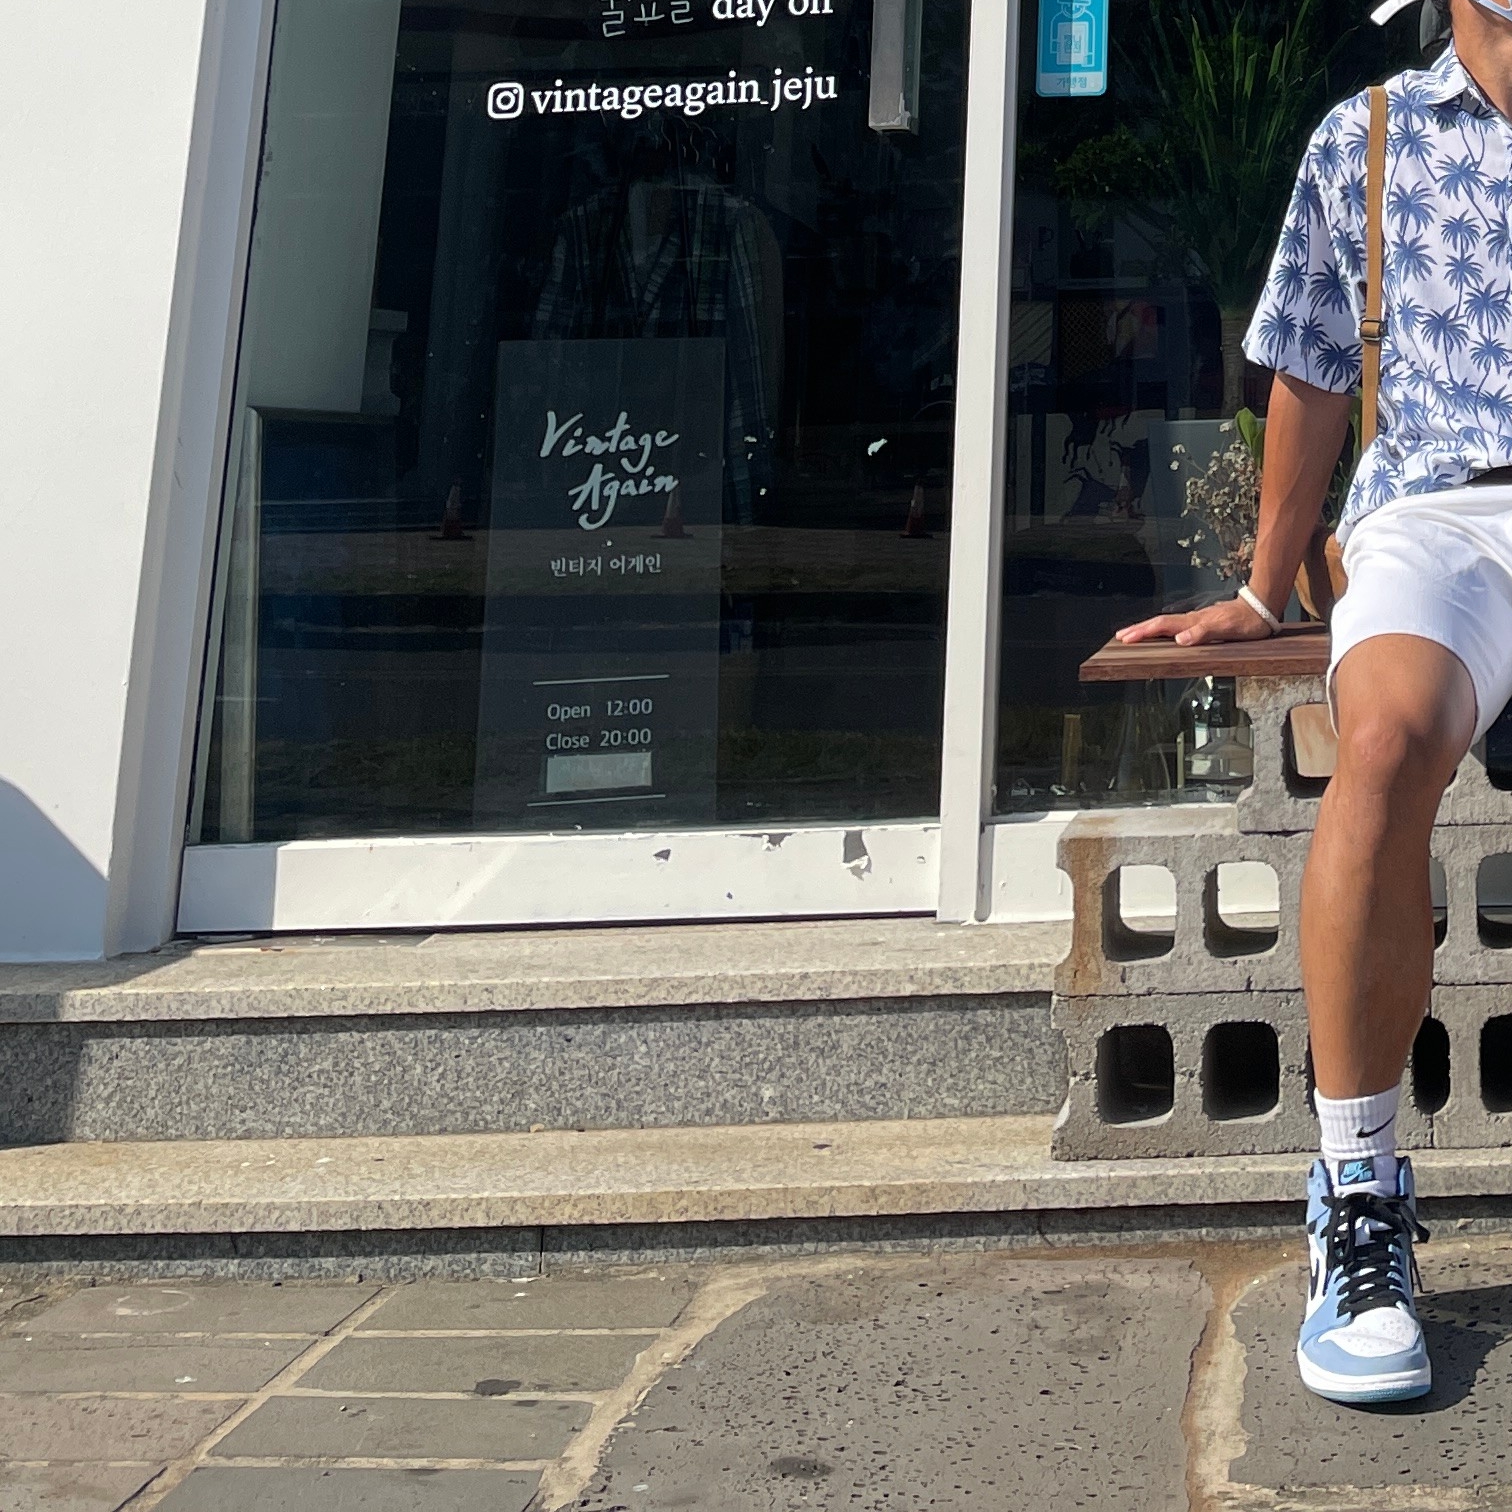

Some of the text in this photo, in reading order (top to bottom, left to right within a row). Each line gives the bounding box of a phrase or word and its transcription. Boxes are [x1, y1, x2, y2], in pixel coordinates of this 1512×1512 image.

[531, 66, 838, 119] vintageagain_jeju
[539, 410, 680, 474] Vintage
[567, 463, 679, 531] Again
[551, 553, 662, 577] 빈티지 어게인
[547, 698, 653, 723] Open 12:00
[545, 728, 652, 750] Close 20:00
